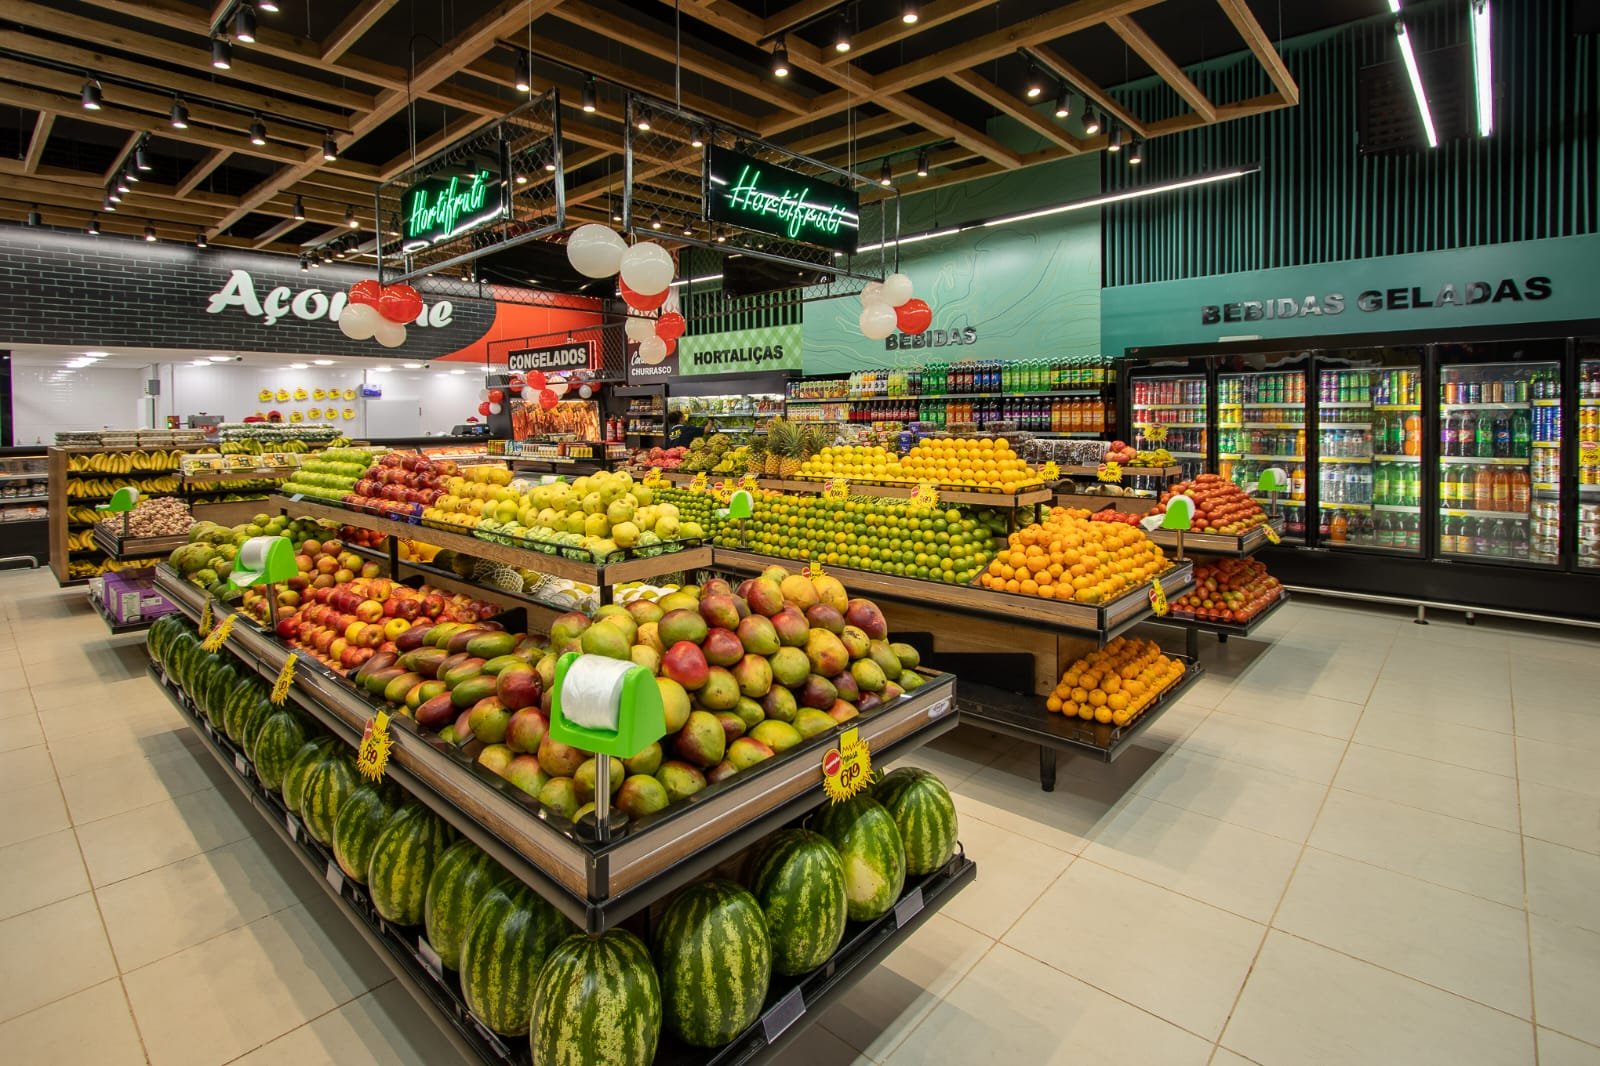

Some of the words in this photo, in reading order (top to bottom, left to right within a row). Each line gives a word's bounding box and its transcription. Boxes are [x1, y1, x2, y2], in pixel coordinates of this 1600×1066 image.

[410, 170, 489, 237] Hortifruti
[730, 164, 846, 238] Hortifruti
[205, 269, 454, 328] Açoue
[1202, 293, 1345, 325] BEBIDAS
[1358, 276, 1553, 312] GELADAS
[694, 345, 784, 365] HORTALIÇAS
[885, 327, 978, 351] BEBIDAS
[509, 347, 587, 370] CONGELADOS
[631, 366, 672, 376] CHURRASCO
